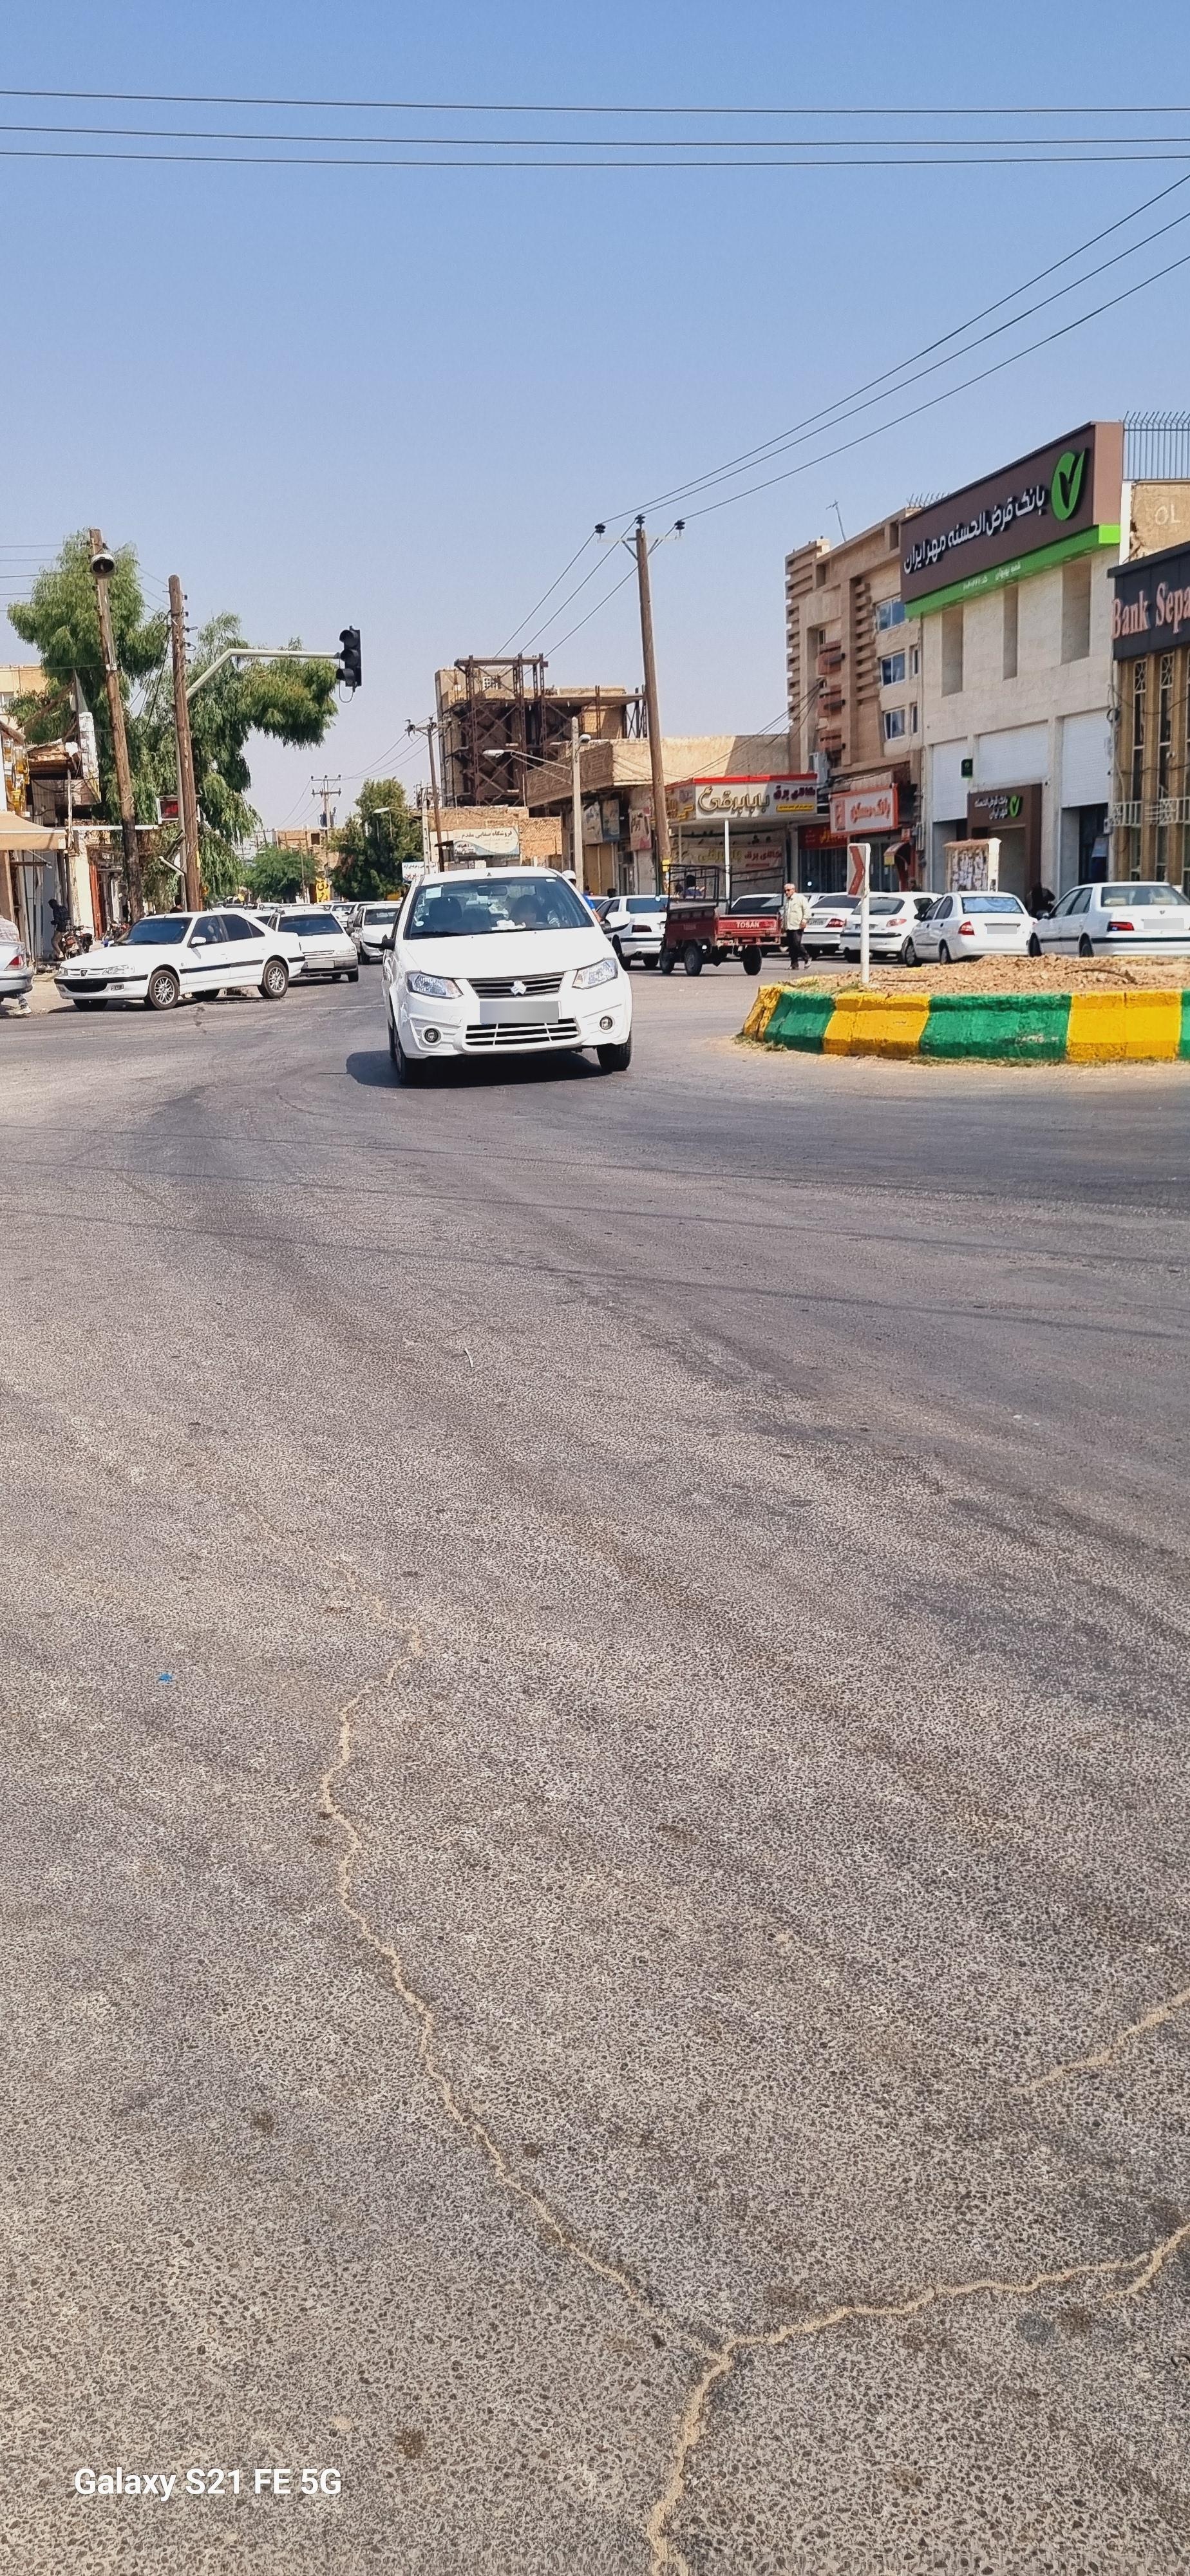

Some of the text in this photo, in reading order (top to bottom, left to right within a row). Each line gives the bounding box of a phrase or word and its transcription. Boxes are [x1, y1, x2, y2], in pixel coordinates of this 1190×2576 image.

[903, 485, 1045, 574] بانک قرض الحسنه مهر ایران
[1112, 590, 1151, 640] Bank
[773, 784, 789, 801] برق
[850, 802, 875, 824] مسکن
